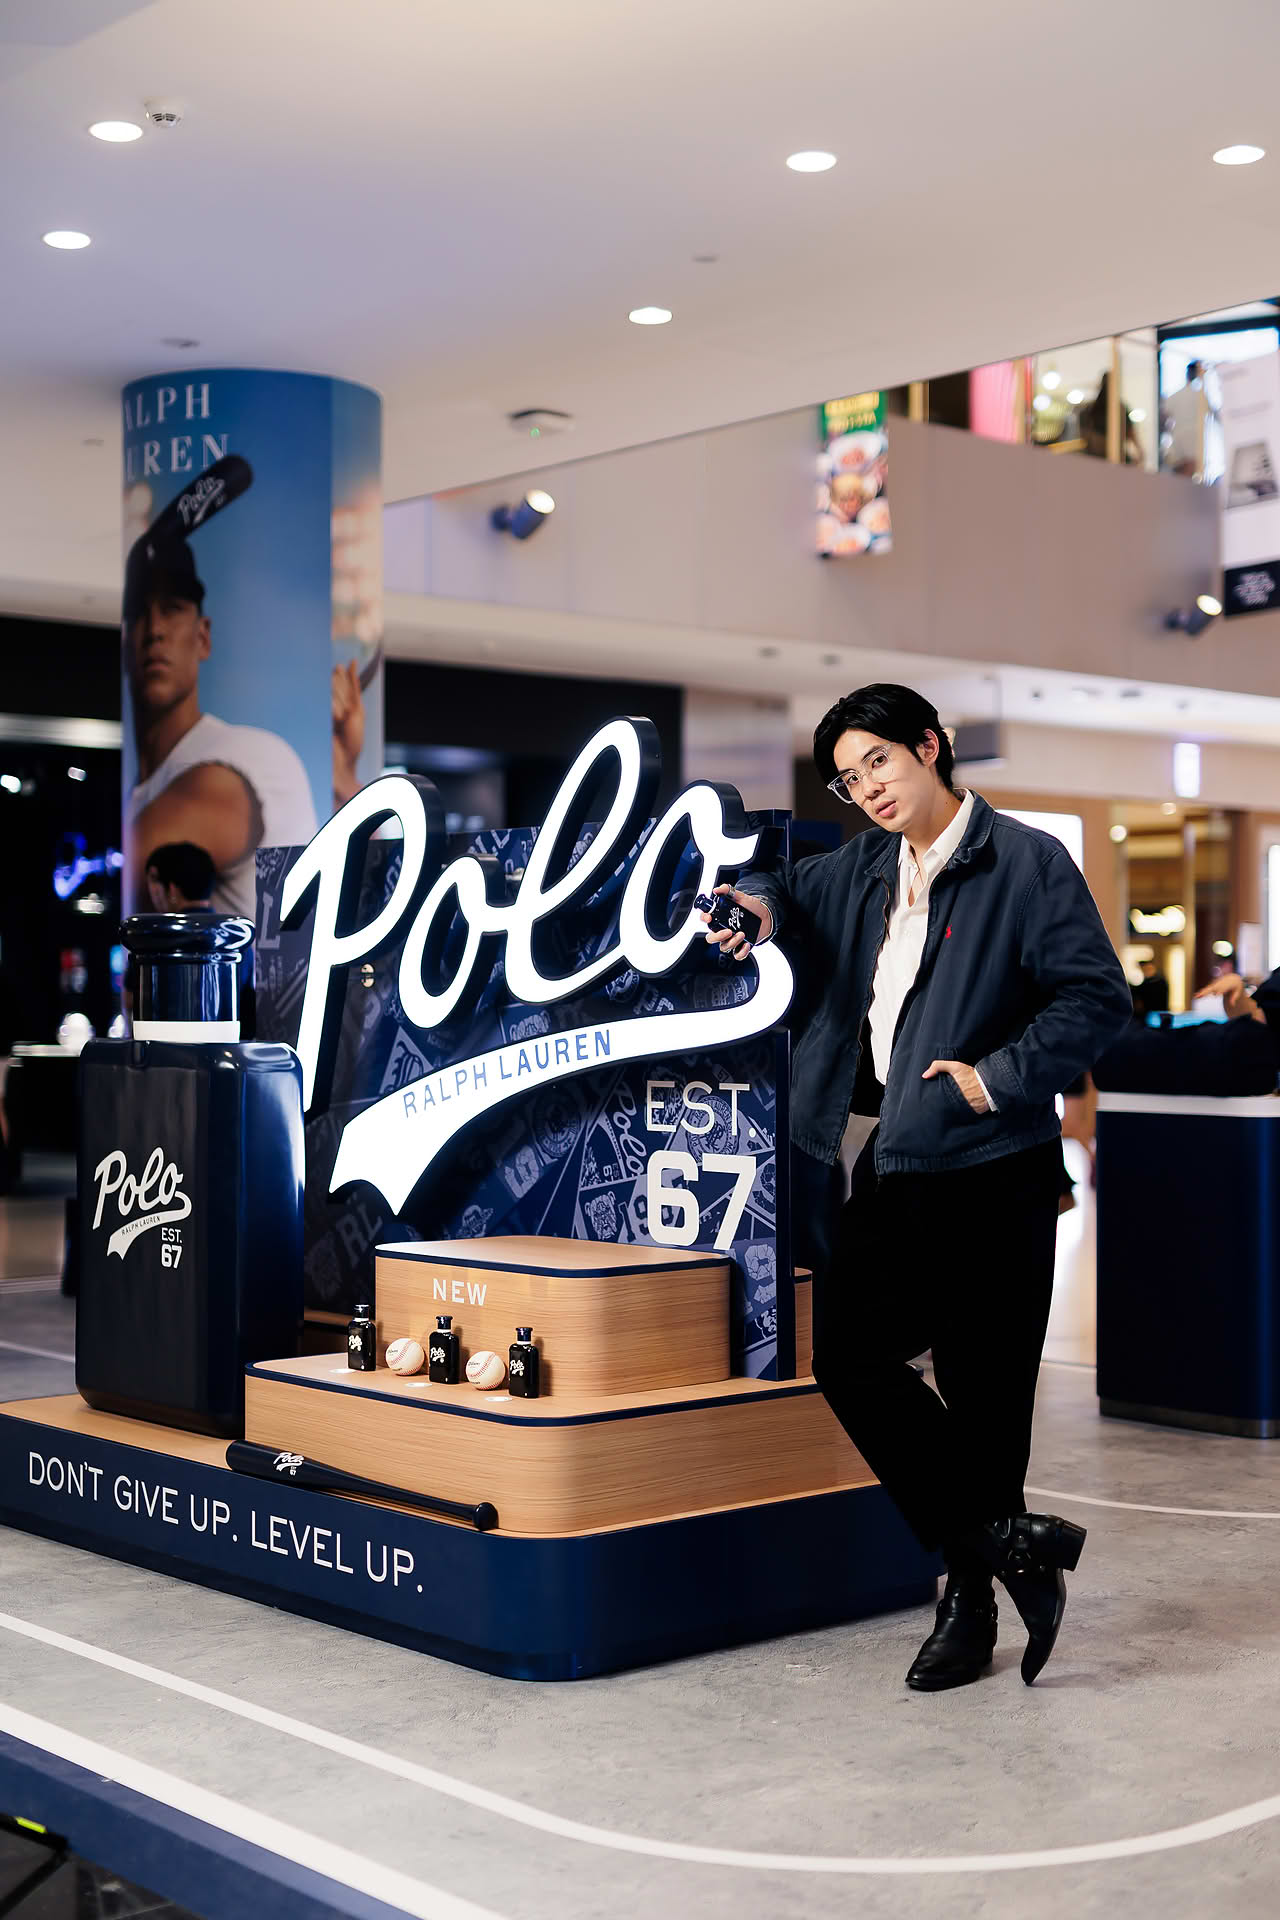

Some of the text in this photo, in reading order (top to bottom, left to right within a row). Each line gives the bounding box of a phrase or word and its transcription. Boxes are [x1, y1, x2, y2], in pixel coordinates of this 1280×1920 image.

[279, 717, 760, 1113] Polo
[403, 1029, 611, 1118] RALPH LAUREN
[647, 1080, 756, 1138] EST.
[93, 1147, 184, 1230] Polo
[647, 1150, 757, 1251] 67
[121, 1216, 161, 1236] RALPH LAUREN
[161, 1227, 183, 1243] EST.
[161, 1243, 183, 1269] 67
[433, 1278, 487, 1306] NEW
[430, 1347, 446, 1359] Polo
[509, 1359, 525, 1371] Polo
[29, 1451, 423, 1593] DON'T GIVE UP. LEVEL UP.
